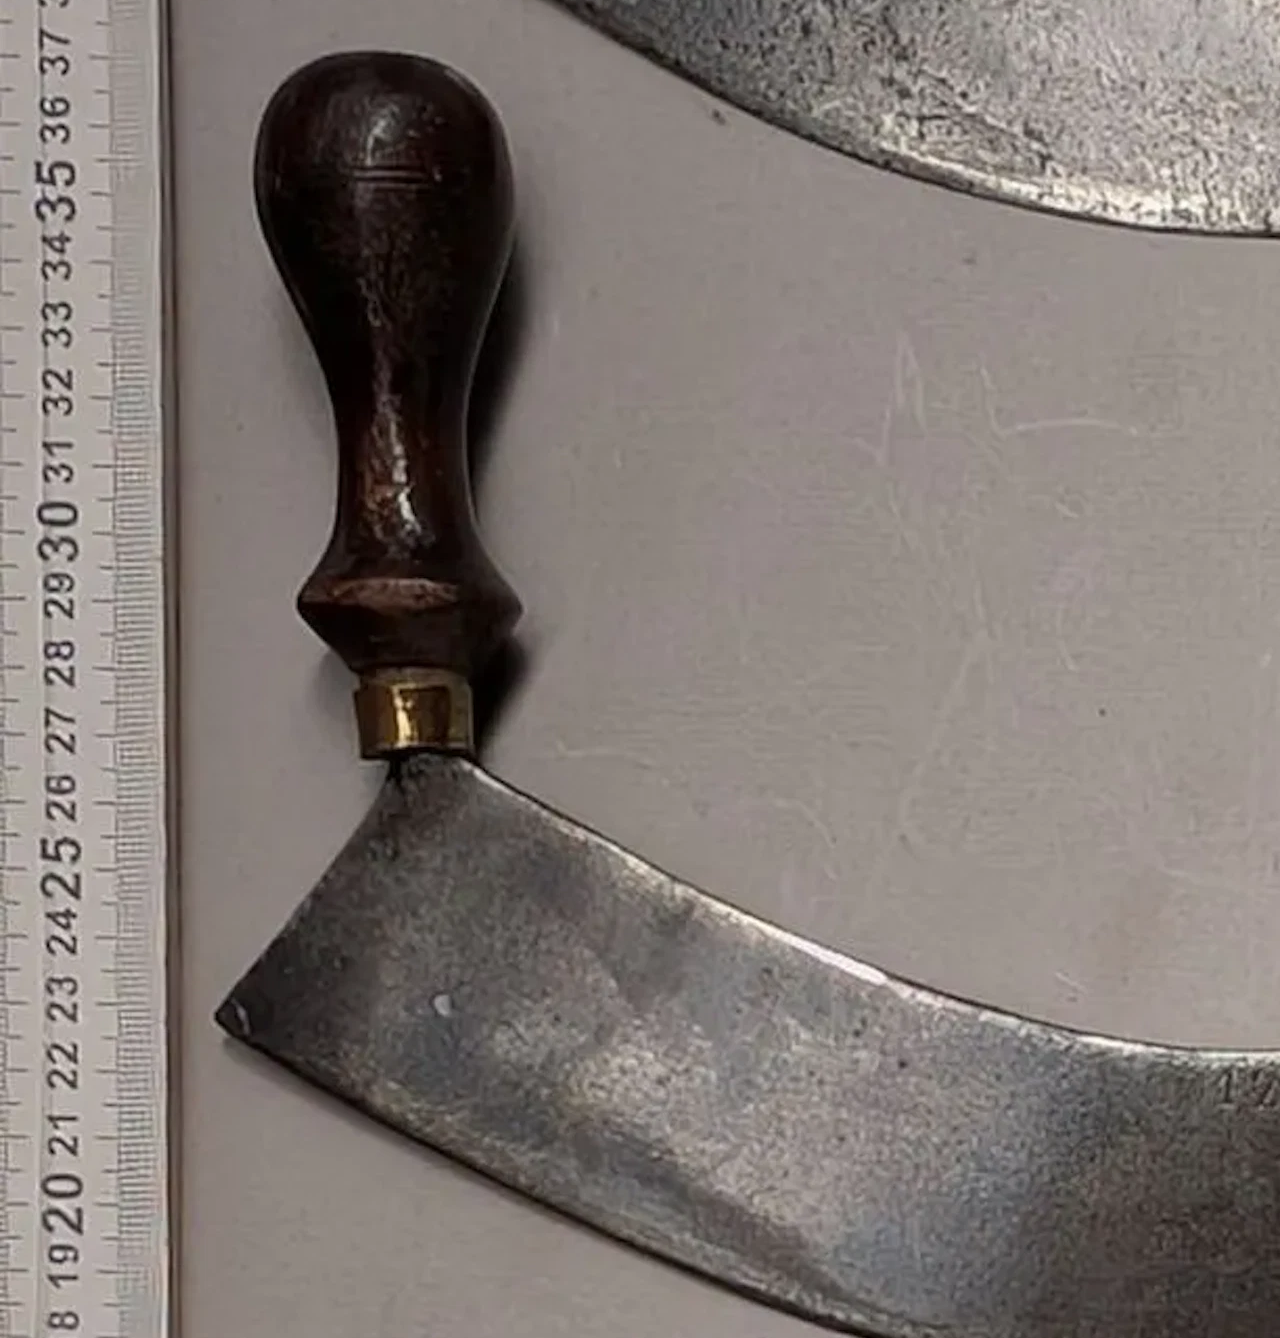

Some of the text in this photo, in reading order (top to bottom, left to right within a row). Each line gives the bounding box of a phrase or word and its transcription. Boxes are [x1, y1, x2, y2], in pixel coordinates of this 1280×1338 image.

[37, 26, 71, 77] 37
[38, 95, 72, 146] 36
[33, 159, 78, 225] 35
[39, 231, 73, 283] 34
[39, 300, 74, 351] 33
[41, 367, 74, 418] 32
[41, 439, 75, 485] 31
[35, 500, 80, 564] 30
[42, 571, 76, 620] 29
[42, 639, 76, 689] 28
[43, 705, 77, 756] 27
[44, 774, 78, 823] 26
[39, 835, 83, 902] 25
[44, 907, 78, 957] 24
[43, 976, 79, 1024] 23
[43, 1041, 79, 1091] 22
[45, 1113, 80, 1158] 21
[39, 1172, 85, 1237] 20
[46, 1243, 80, 1290] 19
